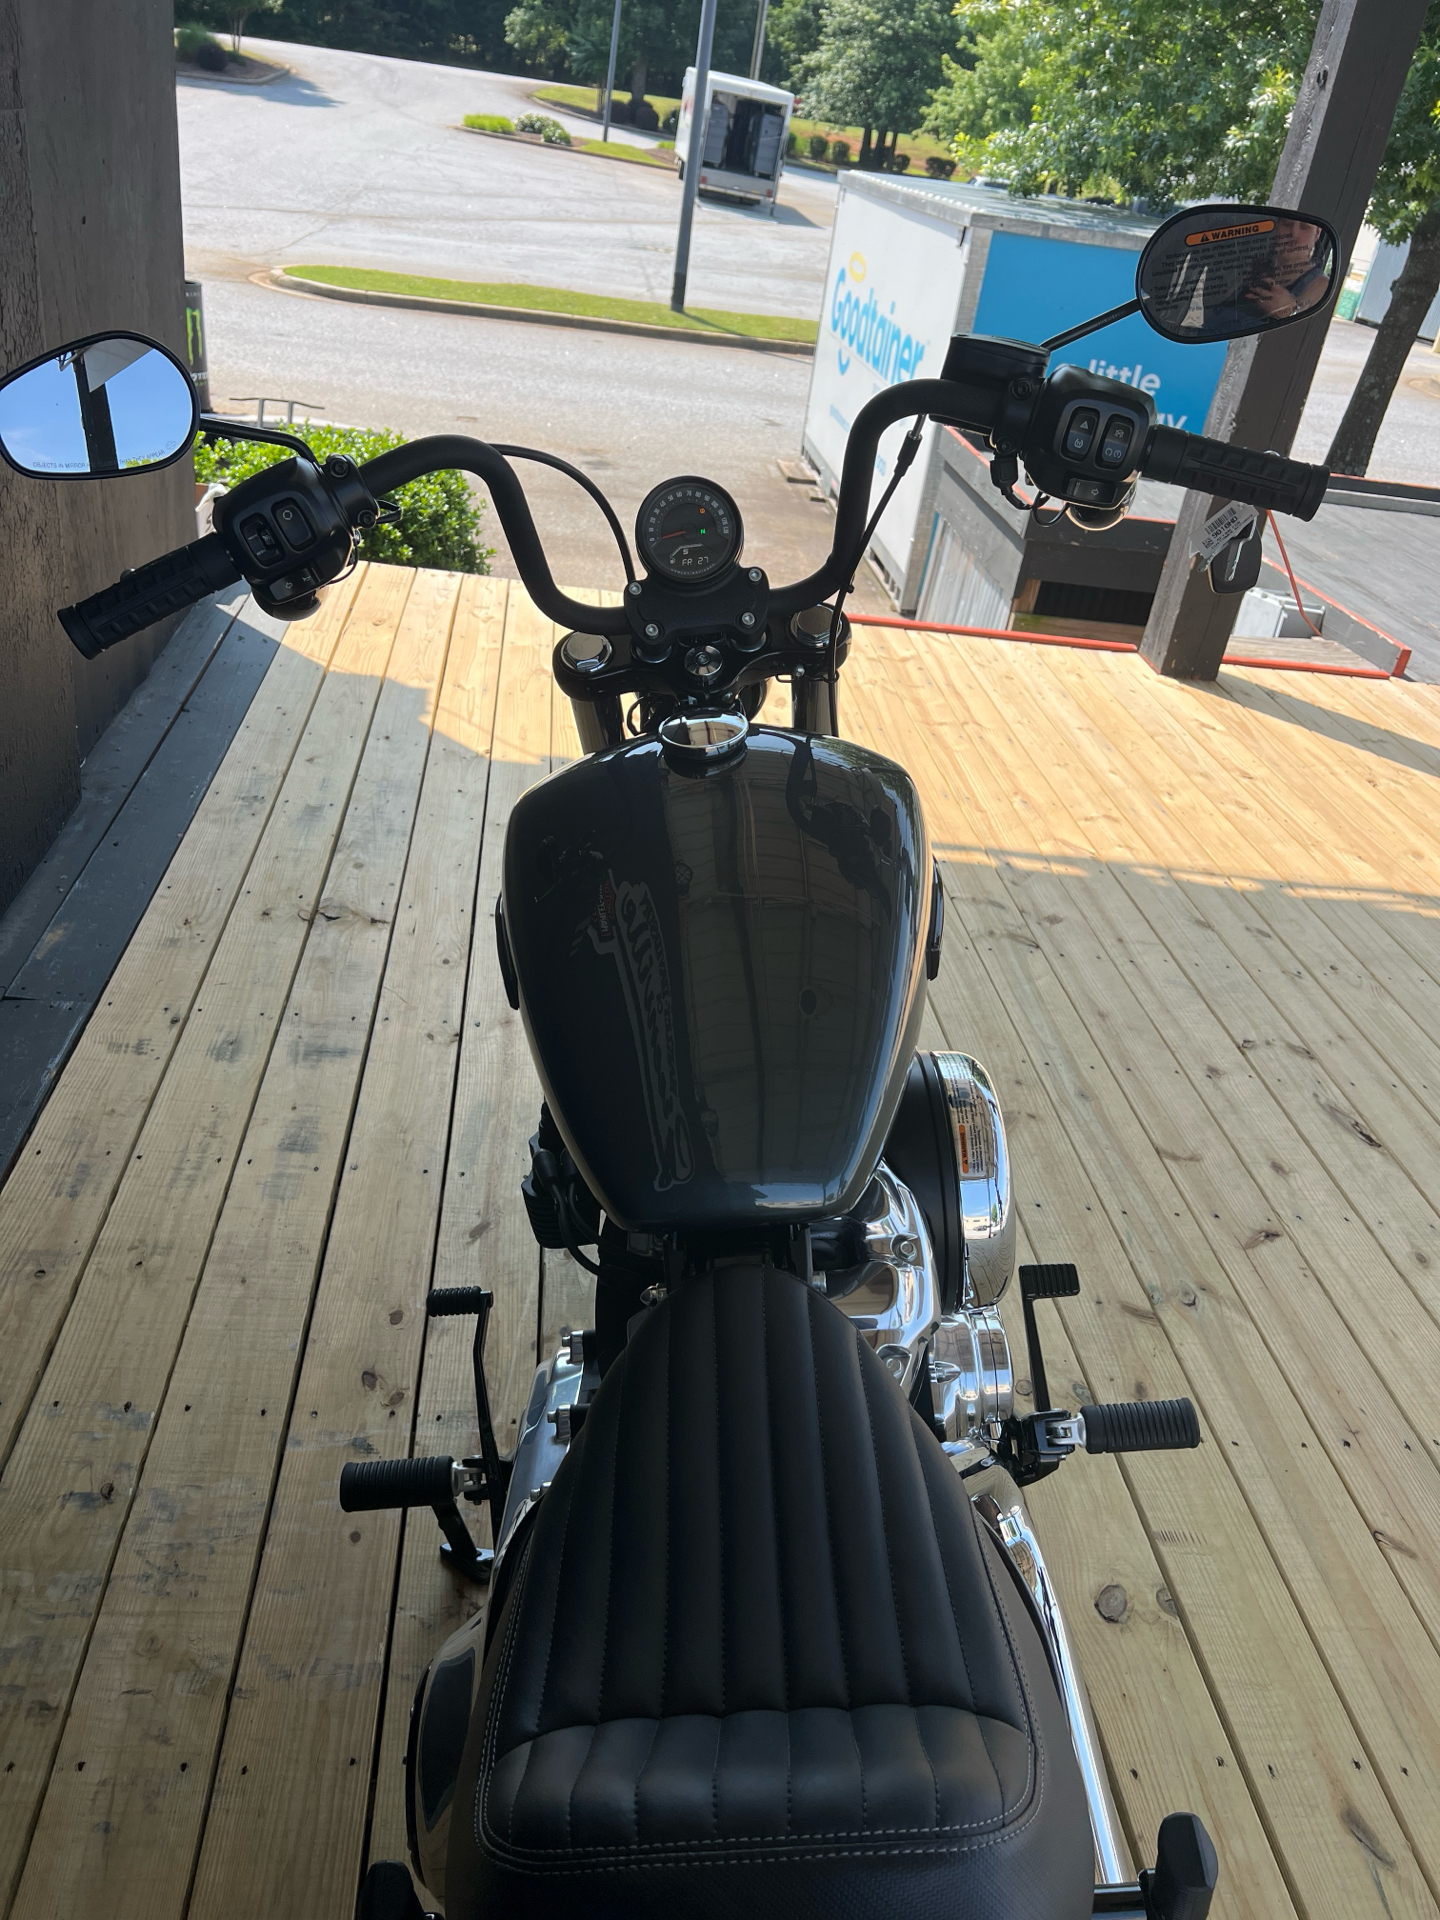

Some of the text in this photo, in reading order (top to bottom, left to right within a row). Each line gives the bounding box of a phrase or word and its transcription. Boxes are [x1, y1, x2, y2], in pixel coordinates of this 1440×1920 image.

[1211, 225, 1259, 240] WARNING
[830, 267, 924, 383] Goodtainer
[1088, 358, 1161, 396] little
